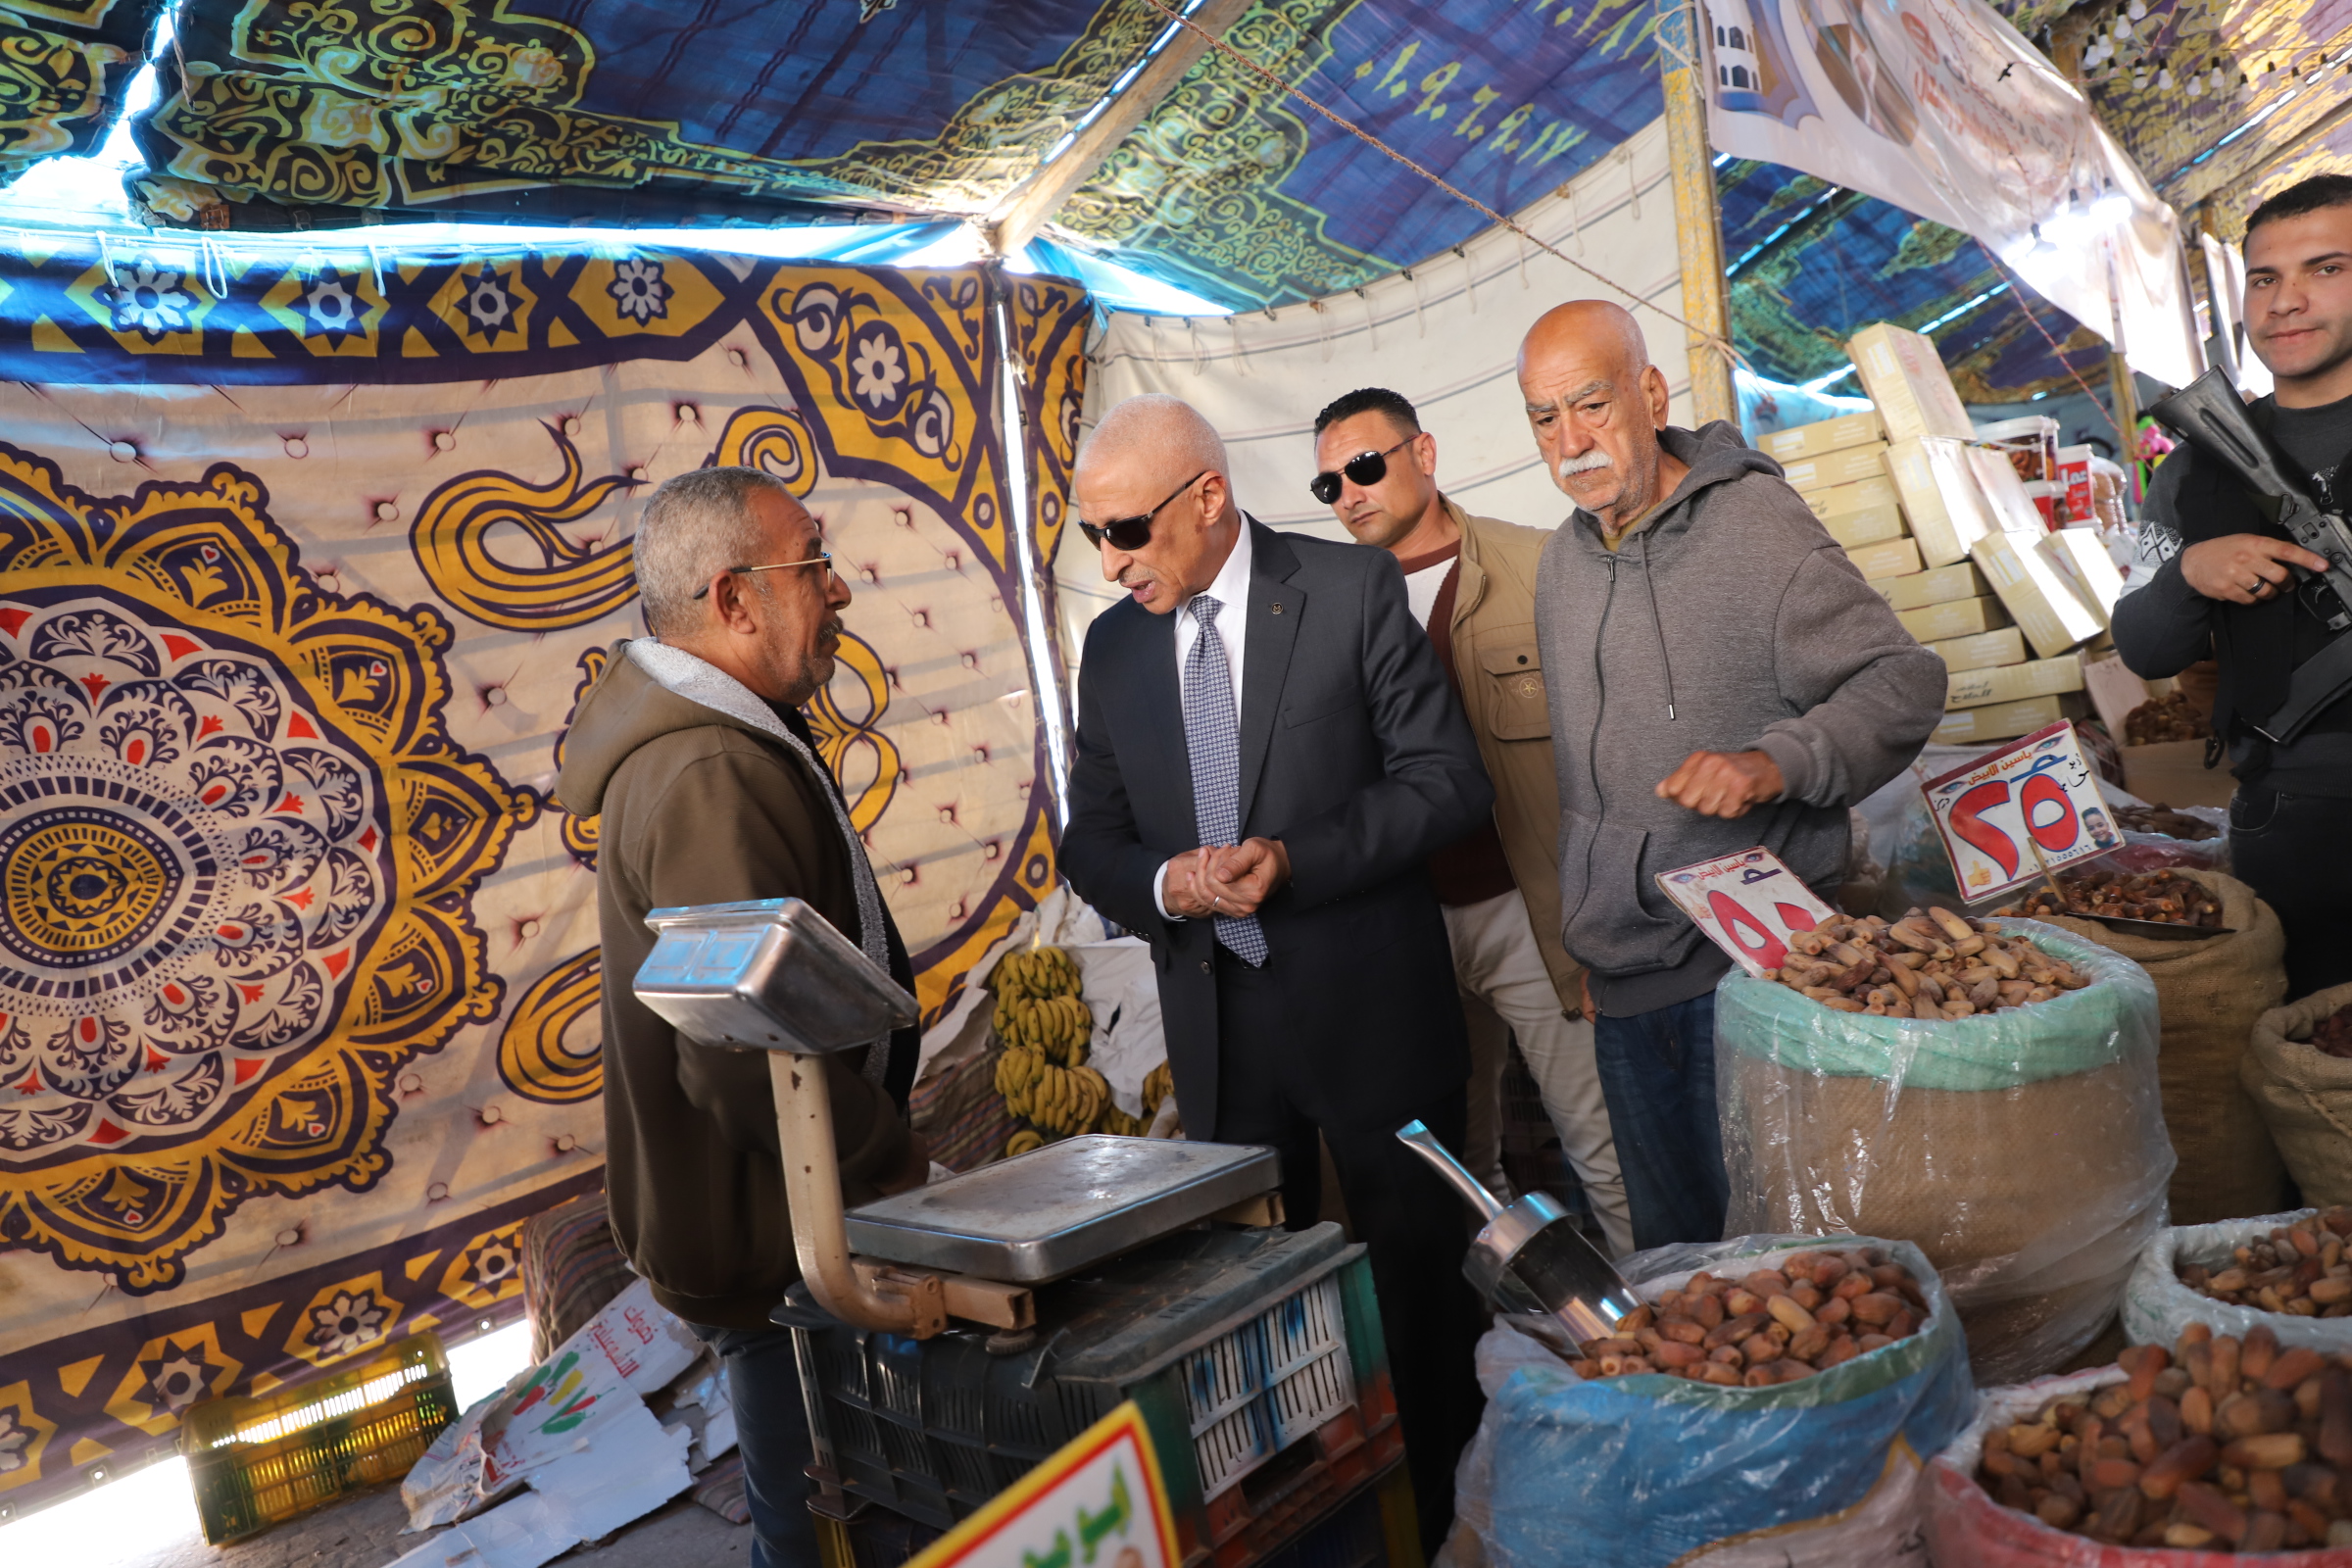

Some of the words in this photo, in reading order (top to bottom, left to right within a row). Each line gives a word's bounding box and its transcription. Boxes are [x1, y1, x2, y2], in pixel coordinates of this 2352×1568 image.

[2001, 750, 2033, 771] ياسين
[1948, 773, 2080, 882] ٢٥
[1723, 858, 1747, 873] ياسين
